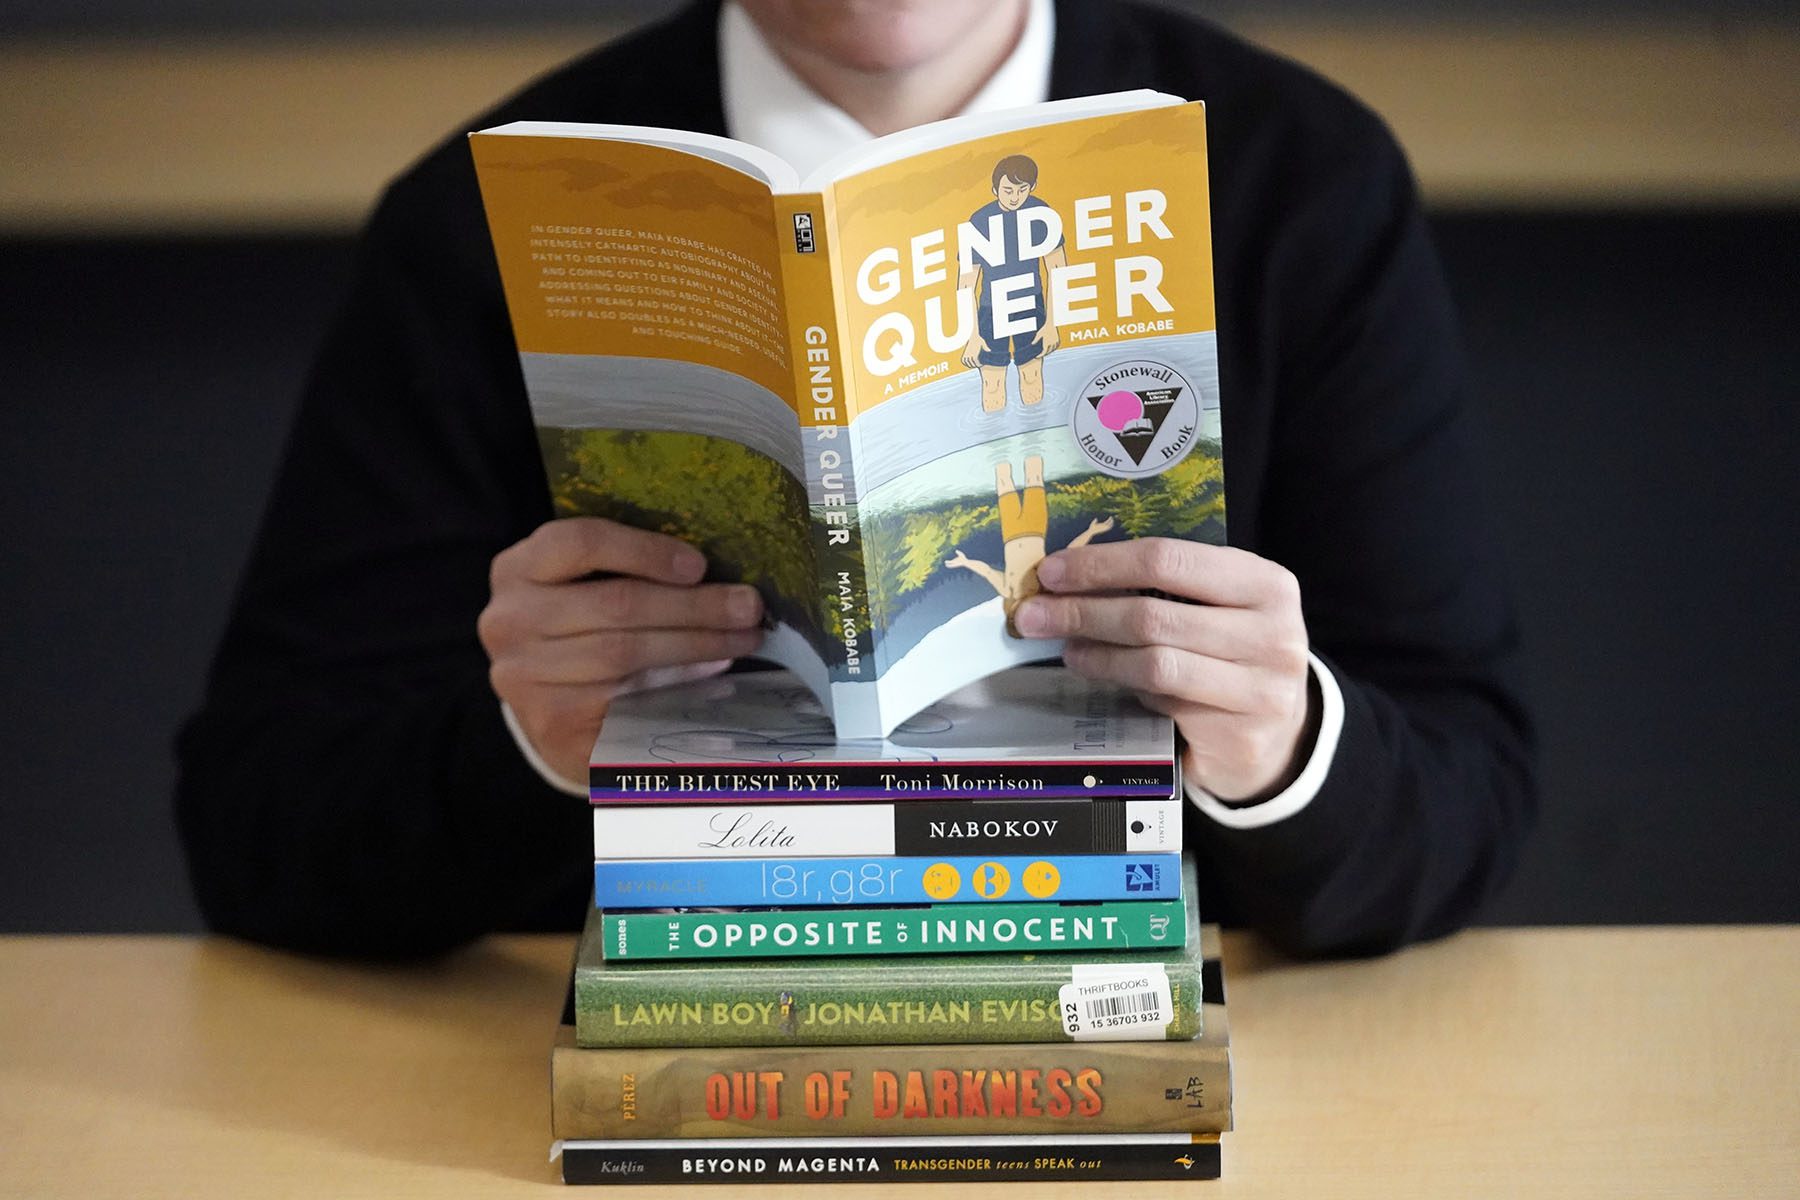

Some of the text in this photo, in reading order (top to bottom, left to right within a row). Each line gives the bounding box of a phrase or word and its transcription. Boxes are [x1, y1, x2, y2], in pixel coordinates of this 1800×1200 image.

[546, 225, 592, 235] GENDER
[638, 231, 664, 241] MAIA
[667, 236, 705, 250] KOBABE
[708, 244, 725, 256] HAS
[855, 189, 1175, 306] GENDER
[531, 253, 562, 261] PATH
[565, 254, 580, 263] TO
[584, 255, 655, 268] IDENTIFYING
[658, 262, 671, 270] AS
[673, 264, 727, 283] NONBINARY
[730, 279, 746, 291] AND
[595, 241, 657, 255] CATHARTIC
[661, 248, 738, 274] AUTOBIOGRAPHY
[542, 267, 566, 276] AND
[569, 268, 615, 278] COMING
[617, 270, 640, 279] OUT
[643, 272, 658, 282] TO
[661, 275, 678, 284] EIR
[680, 278, 714, 292] FAMILY
[717, 287, 734, 300] AND
[613, 284, 676, 298] QUESTIONS
[679, 291, 710, 304] ABOUT
[714, 300, 747, 318] GENDER
[637, 299, 659, 309] AND
[662, 303, 686, 313] HOW
[690, 307, 704, 316] TO
[861, 255, 1175, 376] QUEER
[631, 326, 655, 336] AND
[1070, 319, 1174, 342] MAIA KOBABE
[884, 361, 949, 395] A MEMOIR
[1095, 366, 1173, 390] Stonewall
[805, 325, 850, 546] GENDER QUEER
[1081, 425, 1193, 467] Honor Book
[837, 571, 861, 675] MAIA KOBABE
[616, 773, 1160, 792] THE BLUEST EYE Toni Morrison VINTAGE
[697, 811, 797, 849] Lolita
[929, 820, 1059, 839] NABOKOV
[617, 880, 707, 894] MYRACLE
[668, 916, 1118, 952] THE OPPOSITE OF INNOCENT
[1078, 978, 1149, 996] THRIFTBOOKS
[613, 1002, 702, 1027] LAWN
[712, 1002, 775, 1026] BOY
[803, 1001, 971, 1026] JONATHAN
[1066, 1002, 1080, 1033] 932
[1090, 1012, 1160, 1029] 15 36703 932
[623, 1073, 636, 1121] PEREZ
[705, 1068, 1104, 1121] OUT OF DARKNESS
[1186, 1076, 1204, 1108] LAB
[601, 1157, 1102, 1176] Kuklin BEYOND MAGENTA TRANSGENDER teens SPEAK out
